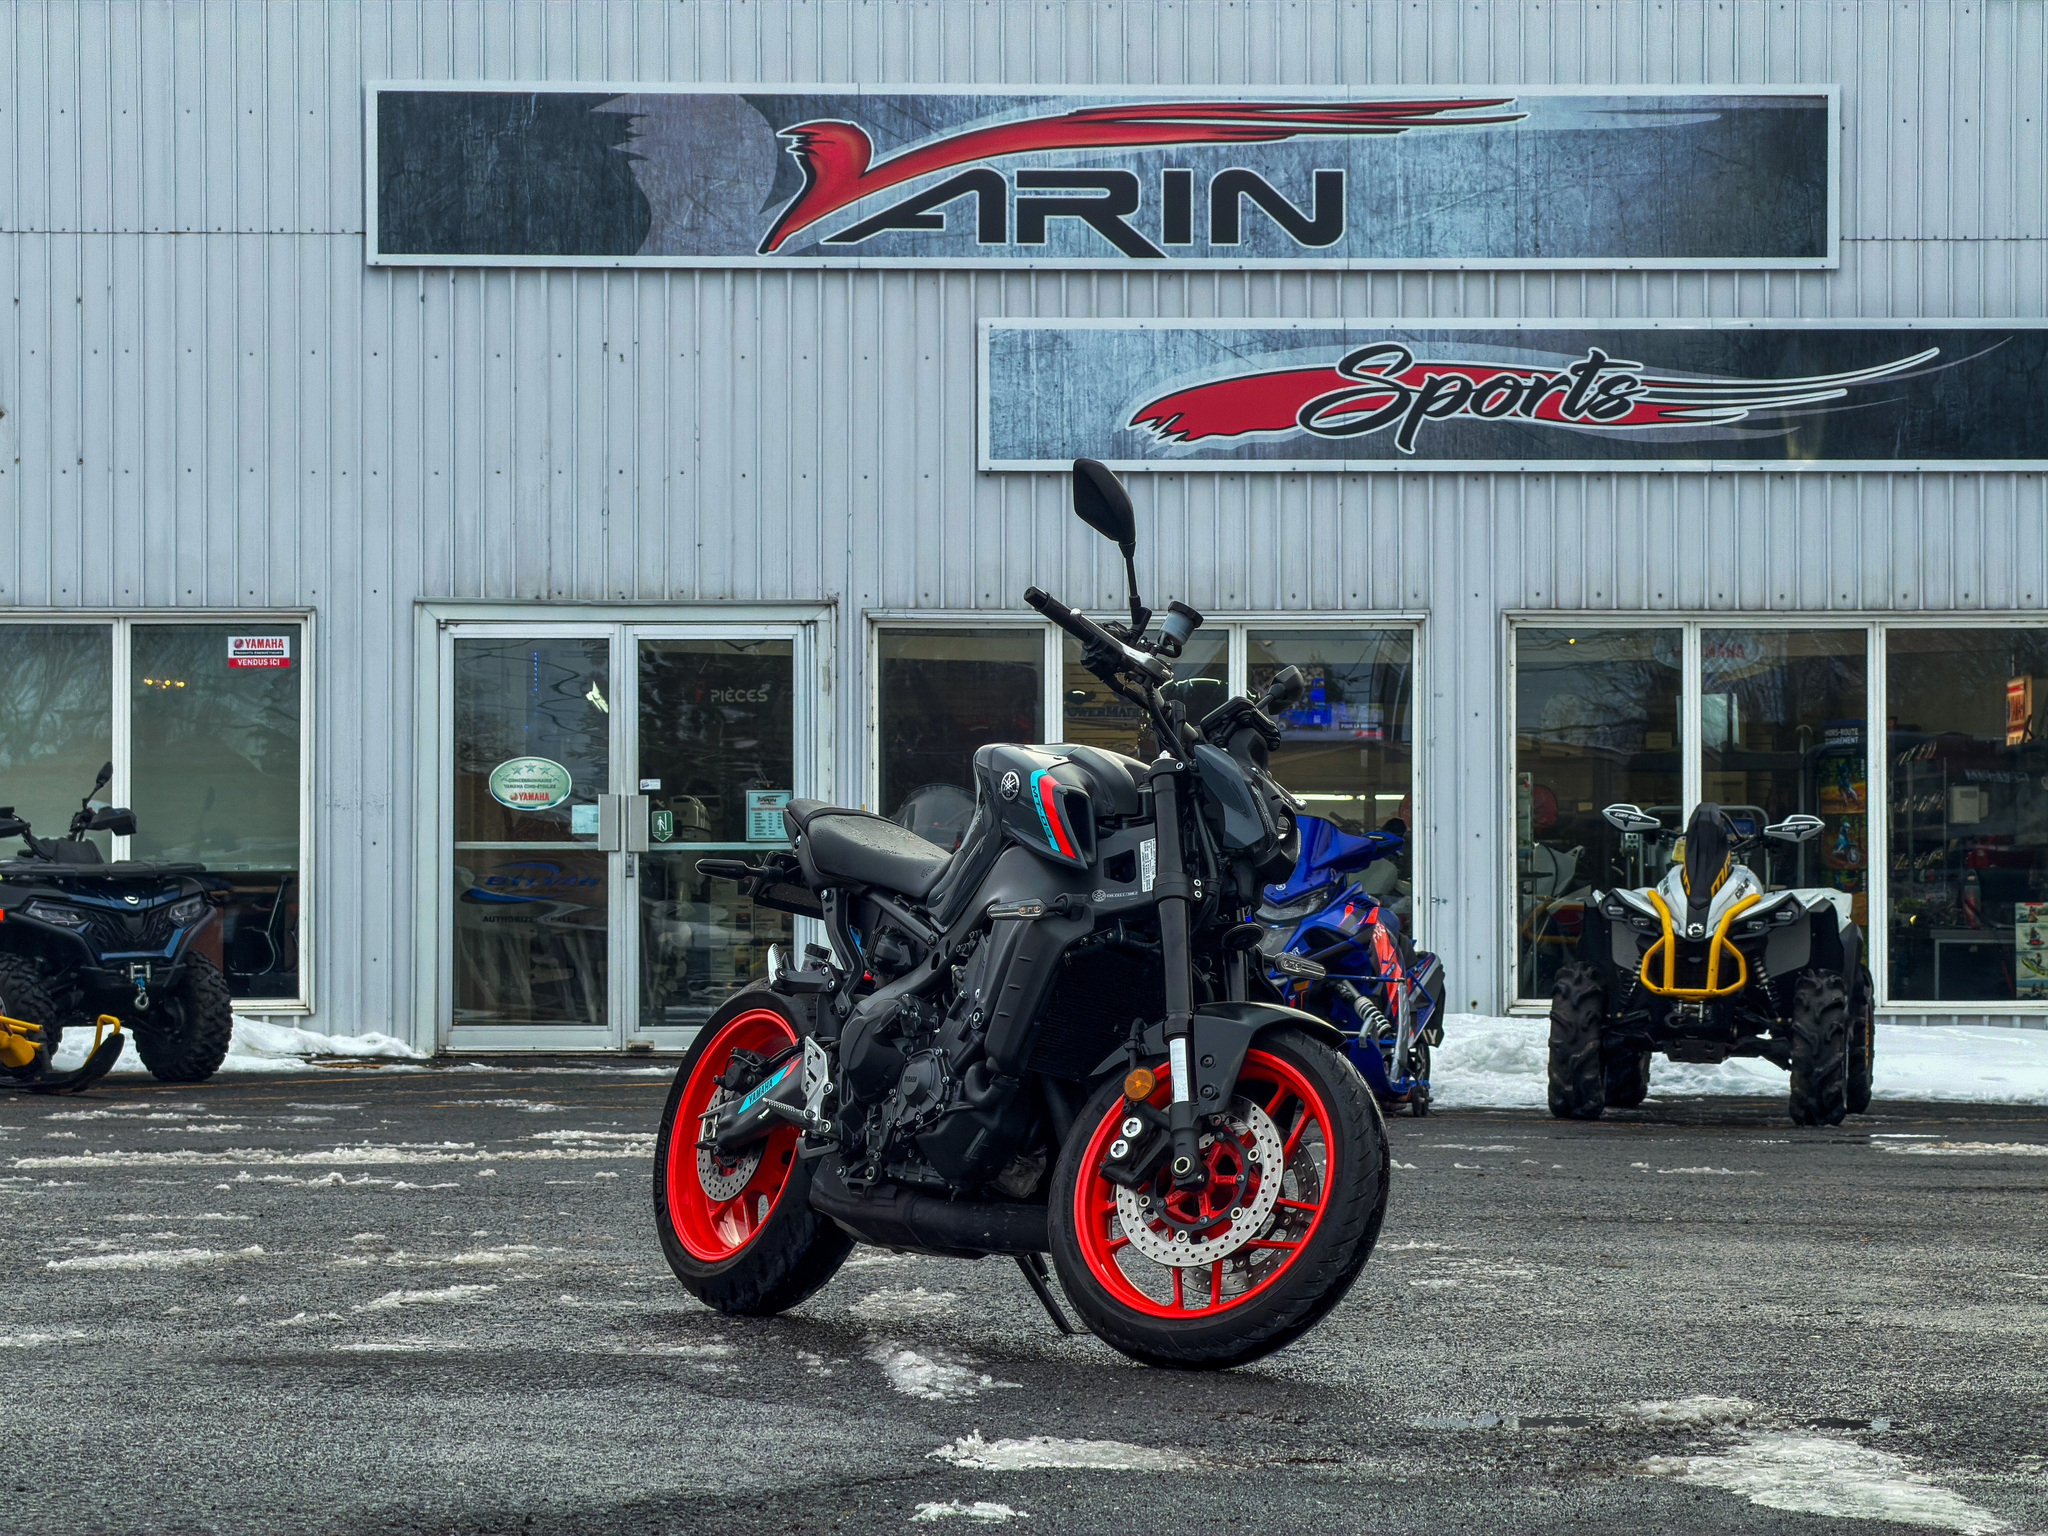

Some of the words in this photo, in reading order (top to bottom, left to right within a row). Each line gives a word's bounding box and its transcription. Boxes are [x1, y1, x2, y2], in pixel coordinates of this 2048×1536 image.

[1298, 342, 1650, 454] Sports
[245, 638, 284, 649] YAMAHA
[237, 658, 269, 666] VENDUS
[269, 658, 280, 666] ICI
[710, 686, 769, 703] PIÈCES
[519, 792, 550, 801] YAMAHA
[749, 1078, 773, 1104] YAMAHA
